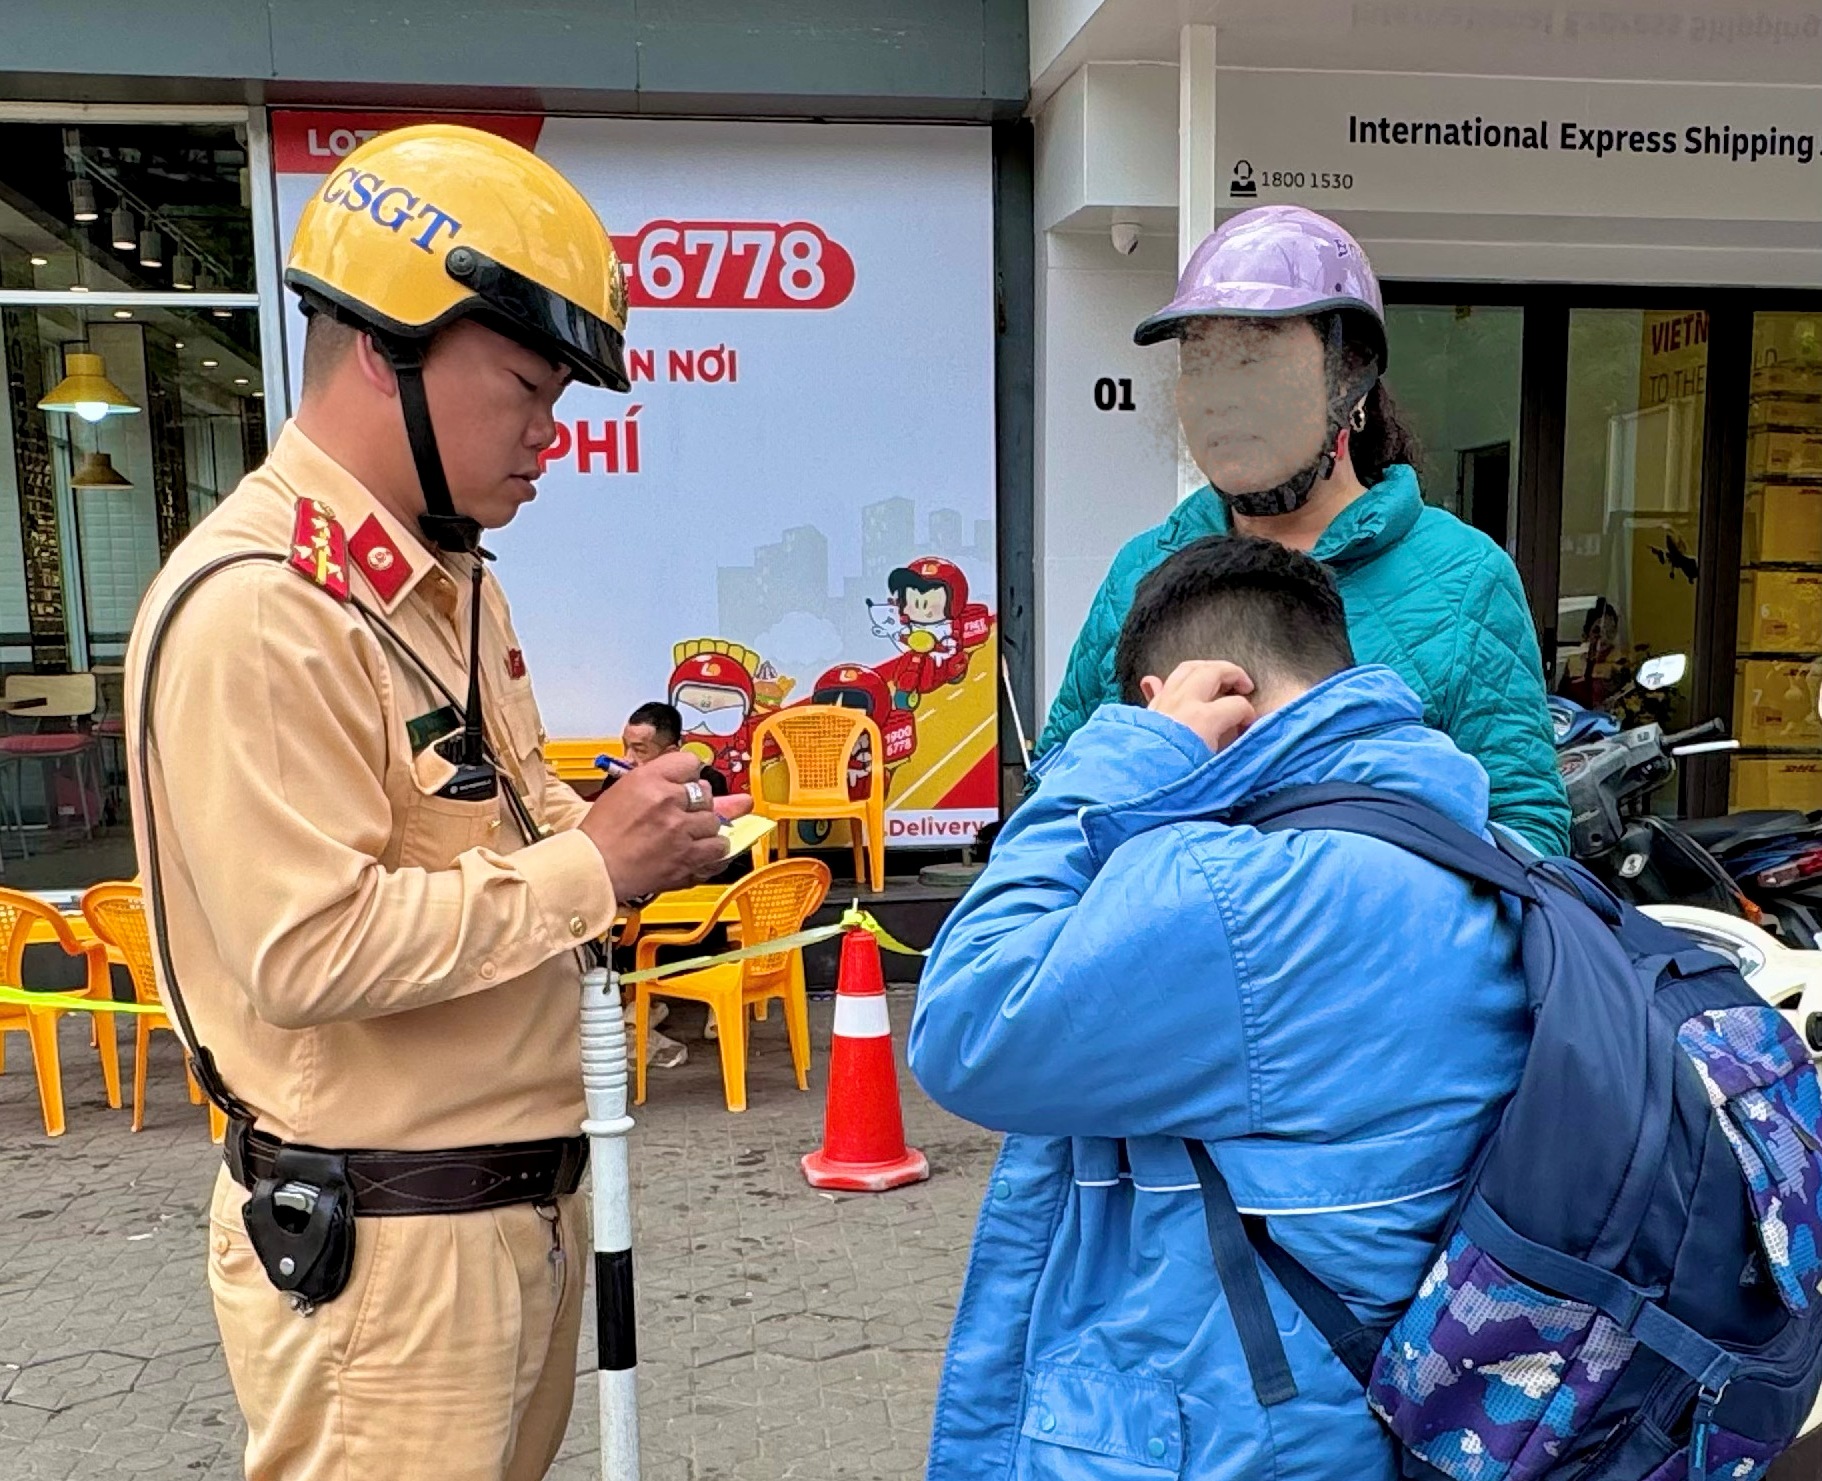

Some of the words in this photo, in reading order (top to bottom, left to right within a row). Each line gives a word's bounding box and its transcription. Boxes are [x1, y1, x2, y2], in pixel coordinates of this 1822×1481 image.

[1350, 116, 1548, 150] International
[1561, 123, 1677, 158] Express
[1684, 125, 1814, 163] Shipping
[1262, 171, 1305, 188] 1800
[1311, 172, 1353, 189] 1530
[323, 167, 463, 254] CSGT
[669, 343, 737, 382] NƠI
[1094, 377, 1136, 411] 01
[1650, 374, 1669, 403] TO
[1674, 365, 1705, 398] THE
